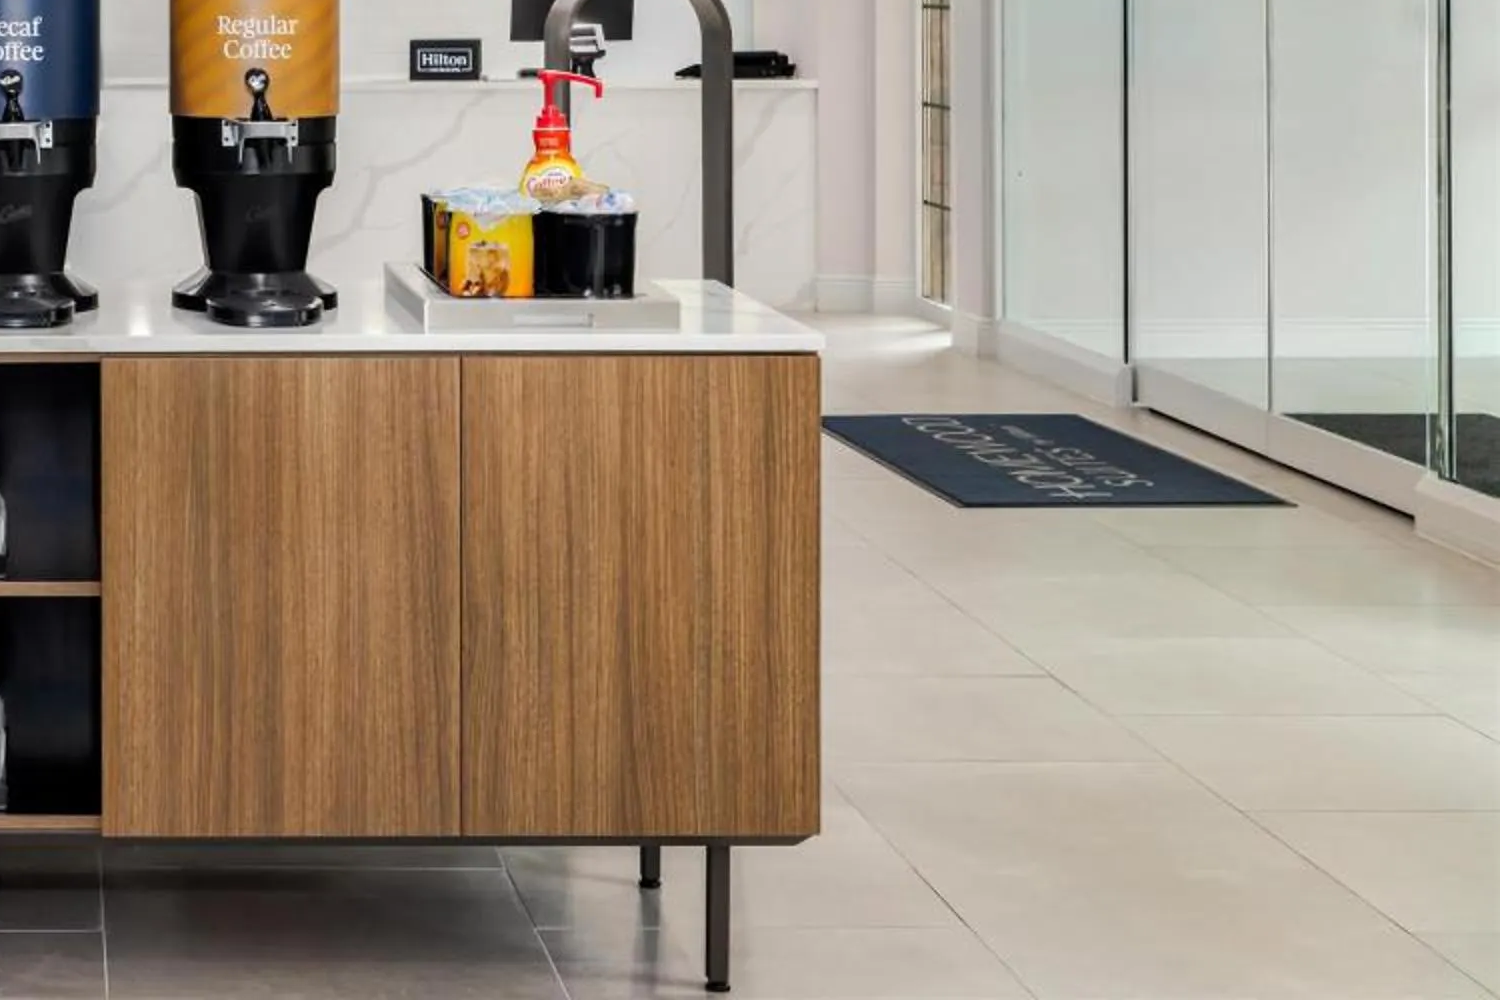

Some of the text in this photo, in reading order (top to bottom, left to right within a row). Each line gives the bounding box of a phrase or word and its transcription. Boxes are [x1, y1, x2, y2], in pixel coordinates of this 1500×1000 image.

[216, 14, 299, 39] Regular
[223, 39, 292, 60] Coffee
[421, 53, 467, 66] Hilton
